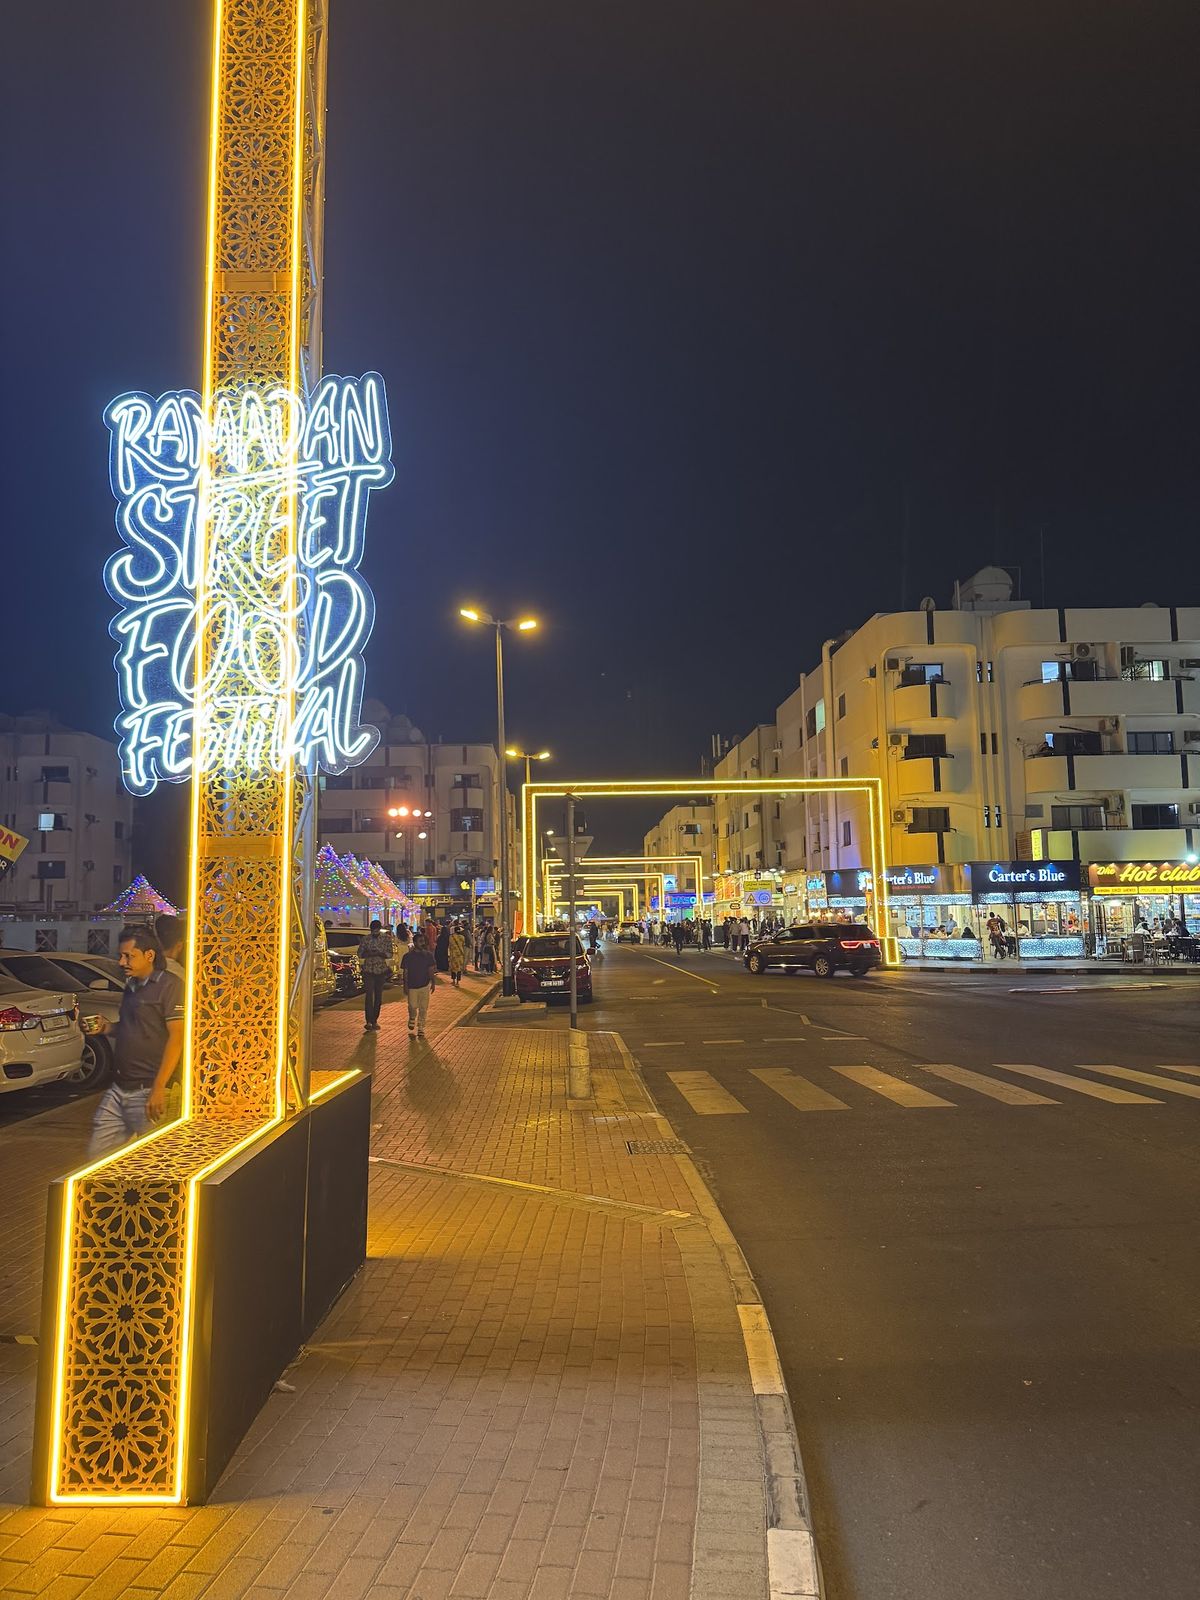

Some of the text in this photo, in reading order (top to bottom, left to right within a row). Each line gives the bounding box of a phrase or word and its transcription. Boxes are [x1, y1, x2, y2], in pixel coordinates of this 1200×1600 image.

[111, 379, 384, 495] RAMADAN
[111, 462, 386, 617] STREET
[117, 572, 366, 710] FOOD
[914, 872, 935, 884] Blue
[988, 869, 1065, 882] Carter's Blue
[1119, 865, 1158, 882] Hot
[1159, 865, 1200, 881] club
